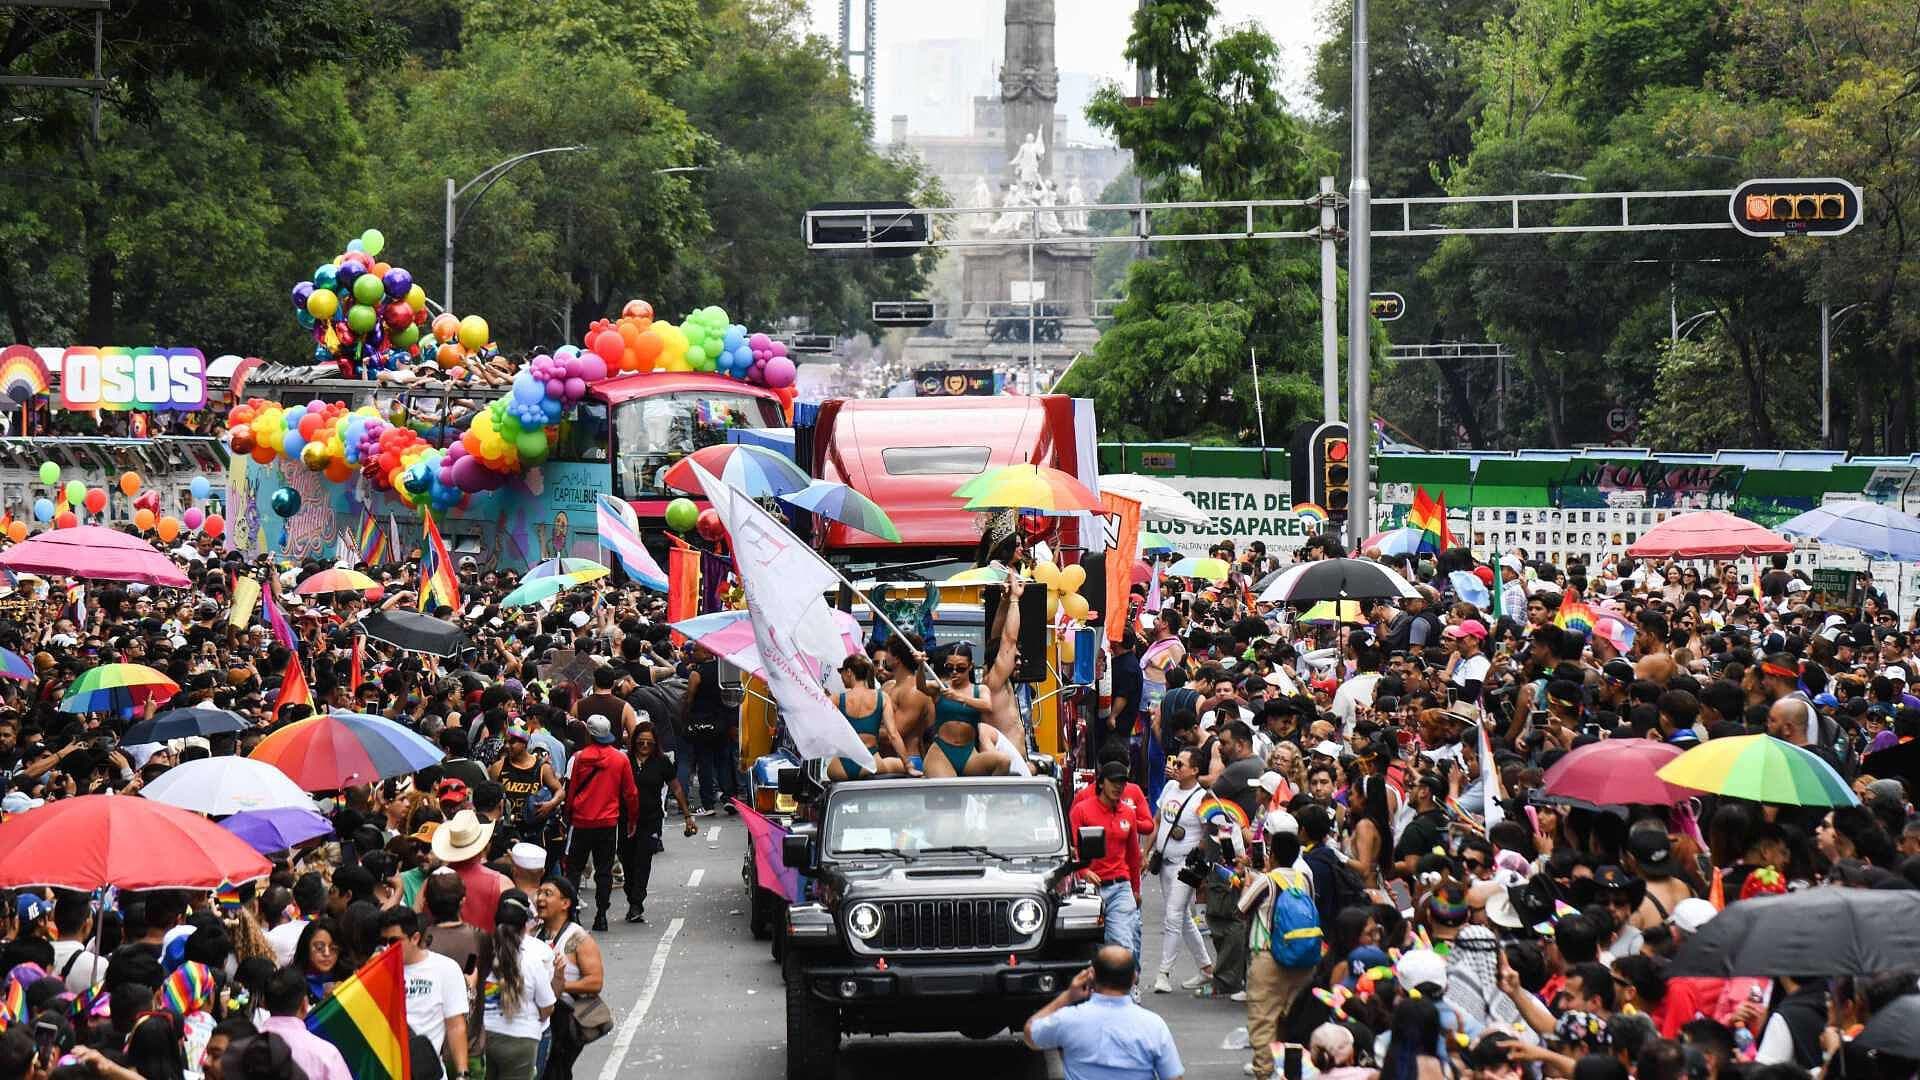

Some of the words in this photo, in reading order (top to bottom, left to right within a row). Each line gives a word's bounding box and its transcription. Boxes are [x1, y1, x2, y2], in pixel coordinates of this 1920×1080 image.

[65, 354, 204, 403] OSOS
[1183, 491, 1257, 511] ORIETA
[1264, 493, 1291, 511] DE
